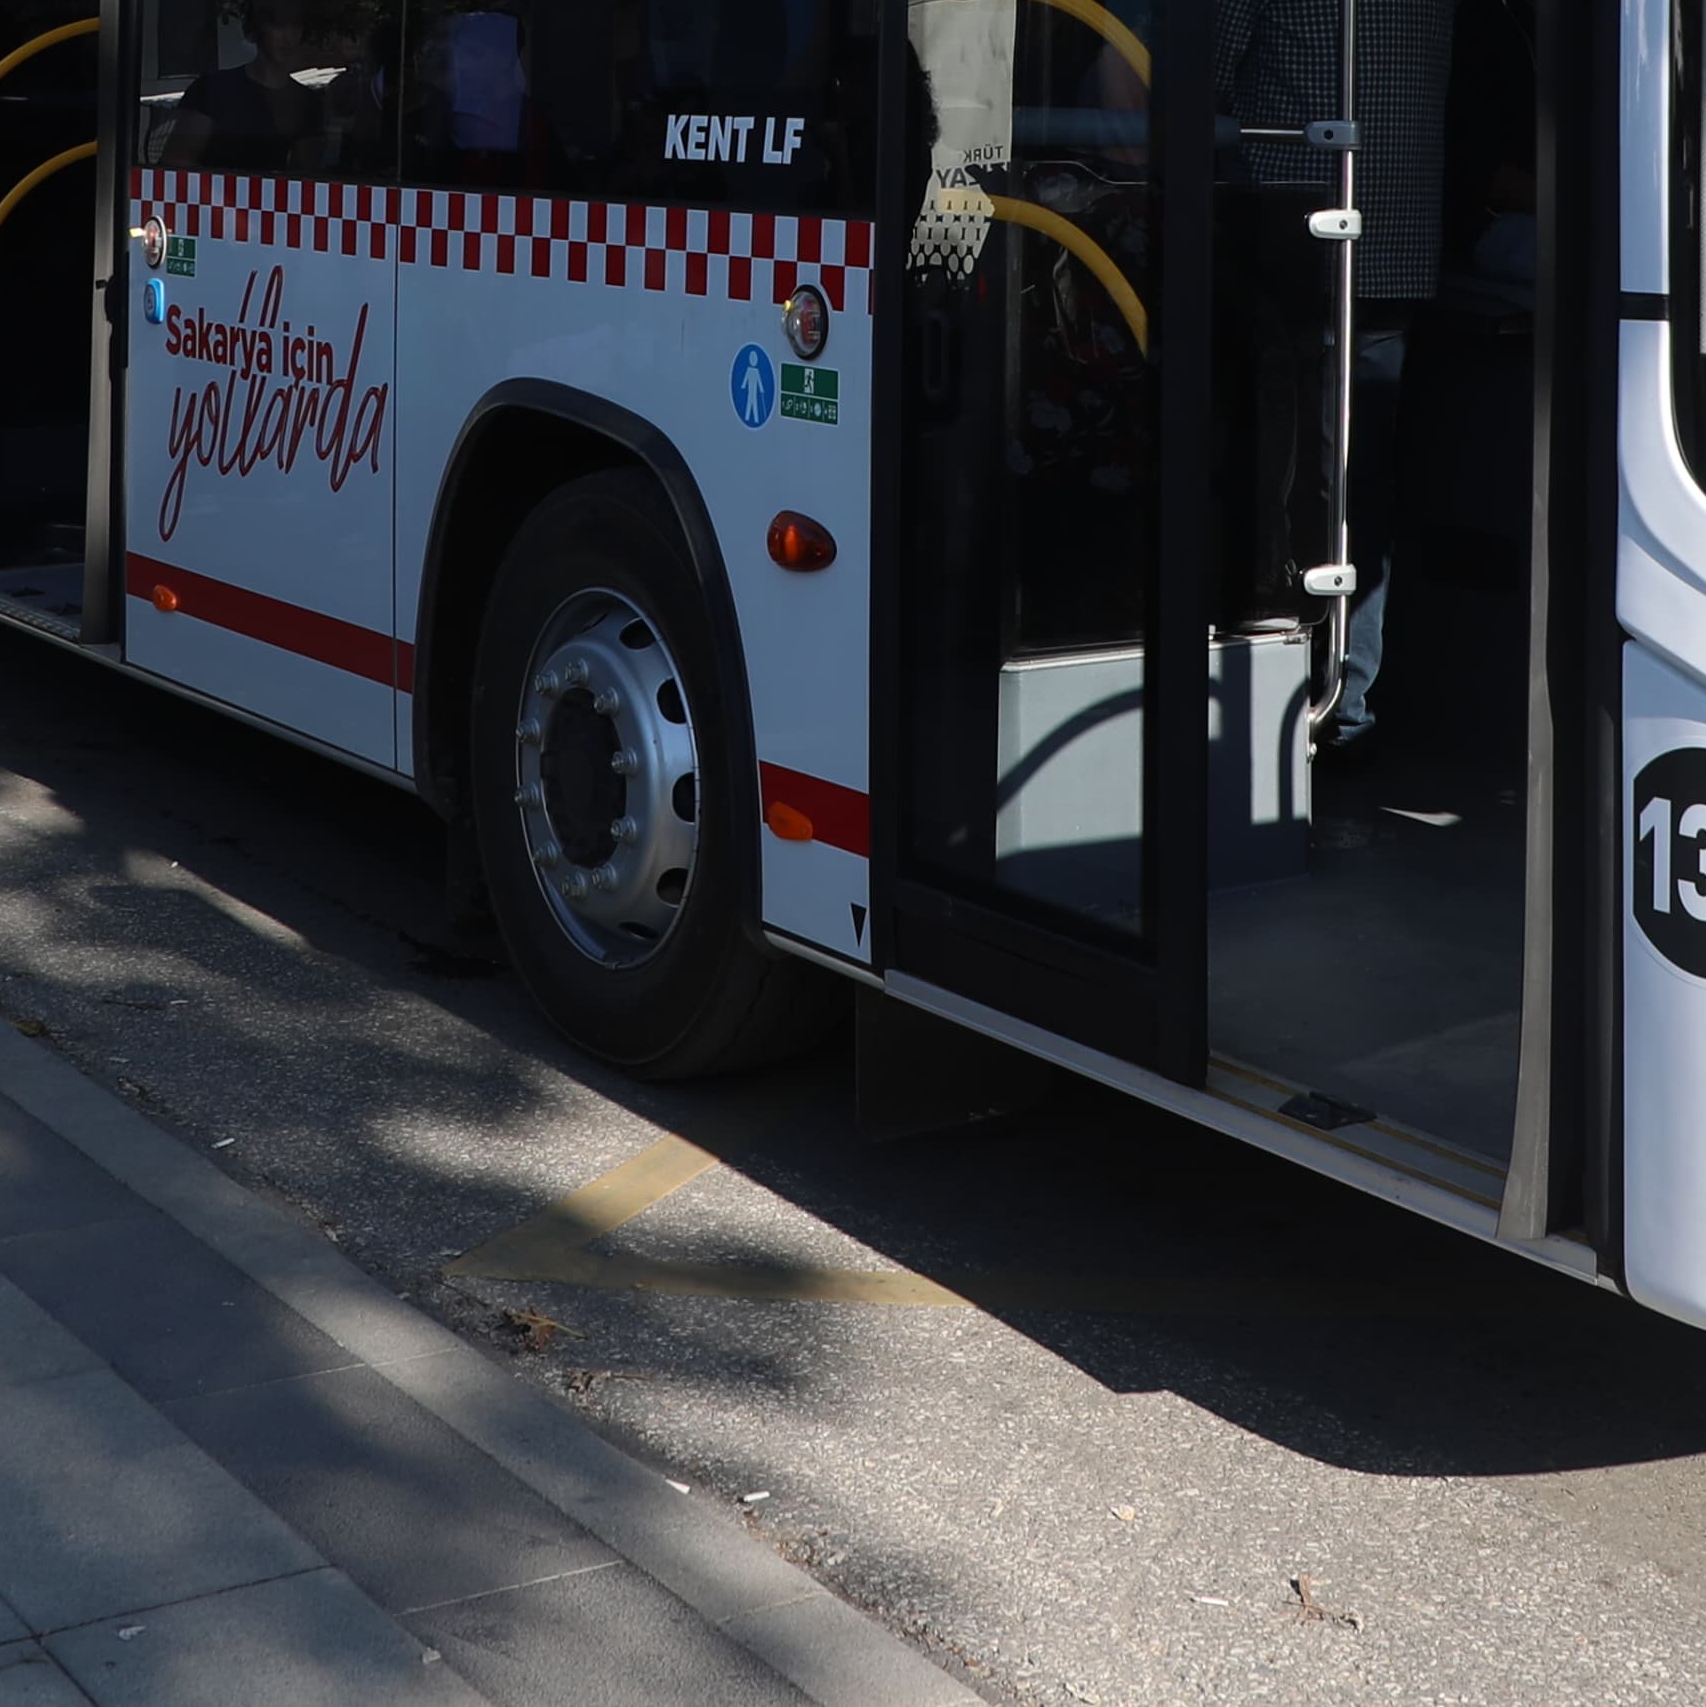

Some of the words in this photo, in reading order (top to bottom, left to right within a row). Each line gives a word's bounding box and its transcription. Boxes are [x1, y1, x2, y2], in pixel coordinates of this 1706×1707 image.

[664, 114, 755, 163] KENT
[762, 116, 805, 165] LF
[165, 303, 273, 381] Sakarya
[282, 320, 335, 390] için
